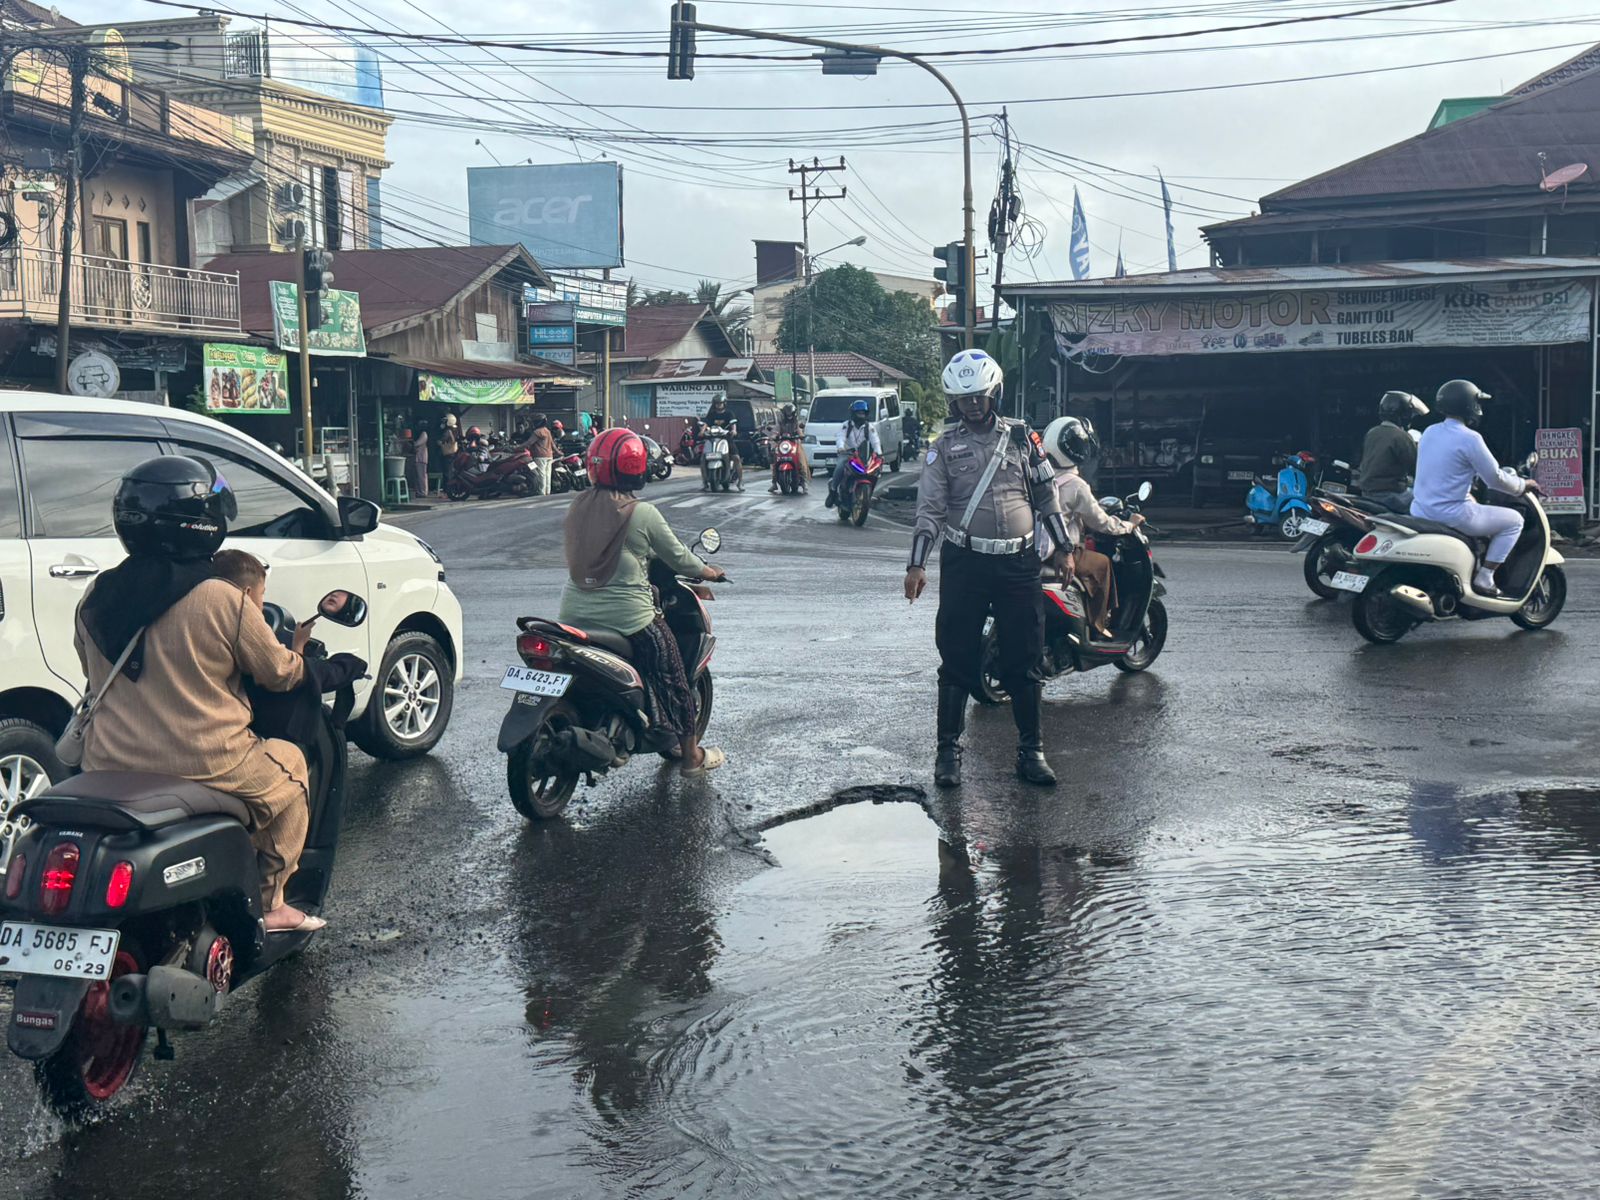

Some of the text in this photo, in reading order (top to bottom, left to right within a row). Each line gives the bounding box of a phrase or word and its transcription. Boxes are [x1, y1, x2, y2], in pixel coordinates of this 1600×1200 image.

[494, 194, 592, 225] acer
[1337, 289, 1389, 305] SERVICE
[1444, 291, 1569, 308] KUR BANK BSI
[1052, 291, 1332, 335] RIZKY MOTOR
[1337, 310, 1394, 325] GANTI OLI
[534, 327, 569, 339] HiLook
[1336, 329, 1414, 346] TUBELES BAN
[1541, 431, 1576, 440] BENGKEL
[1540, 448, 1578, 459] BUKA
[0, 926, 113, 955] DA 5685 FJ
[16, 1013, 54, 1026] Bungas
